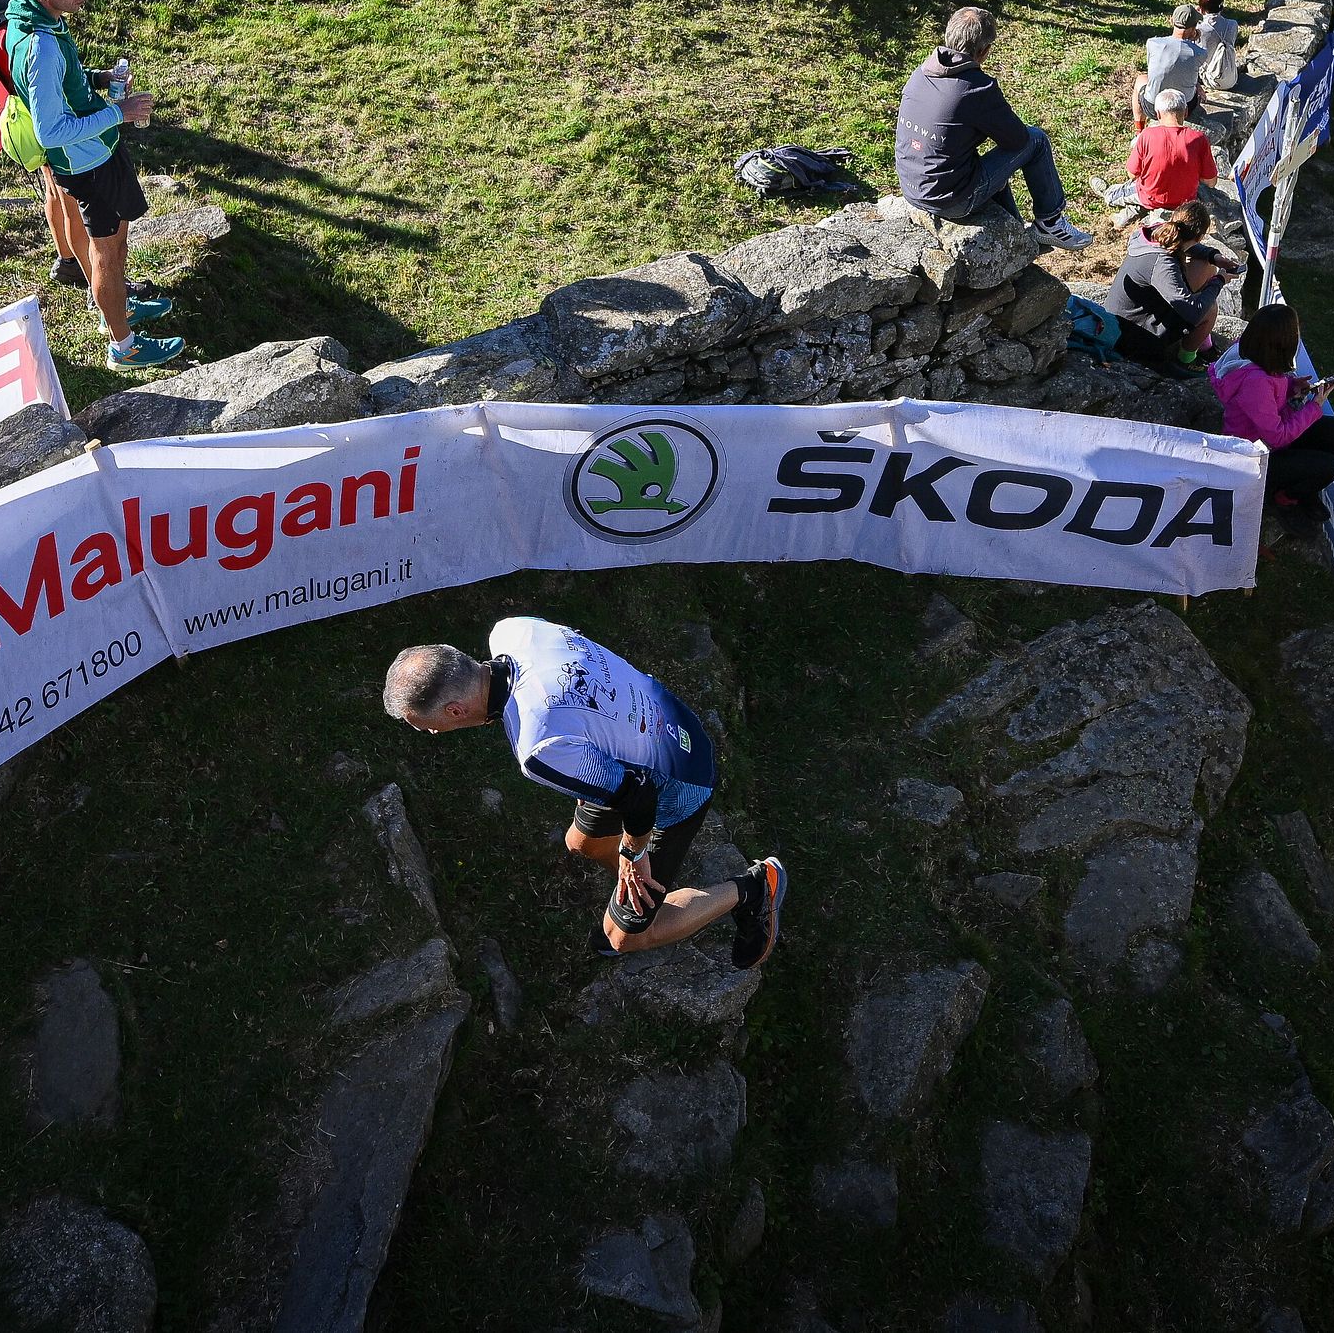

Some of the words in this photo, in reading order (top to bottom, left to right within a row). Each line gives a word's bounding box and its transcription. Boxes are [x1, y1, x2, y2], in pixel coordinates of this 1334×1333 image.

[767, 430, 1234, 549] ŠKODA
[182, 556, 413, 634] www.malugani.it
[40, 629, 144, 713] 671800
